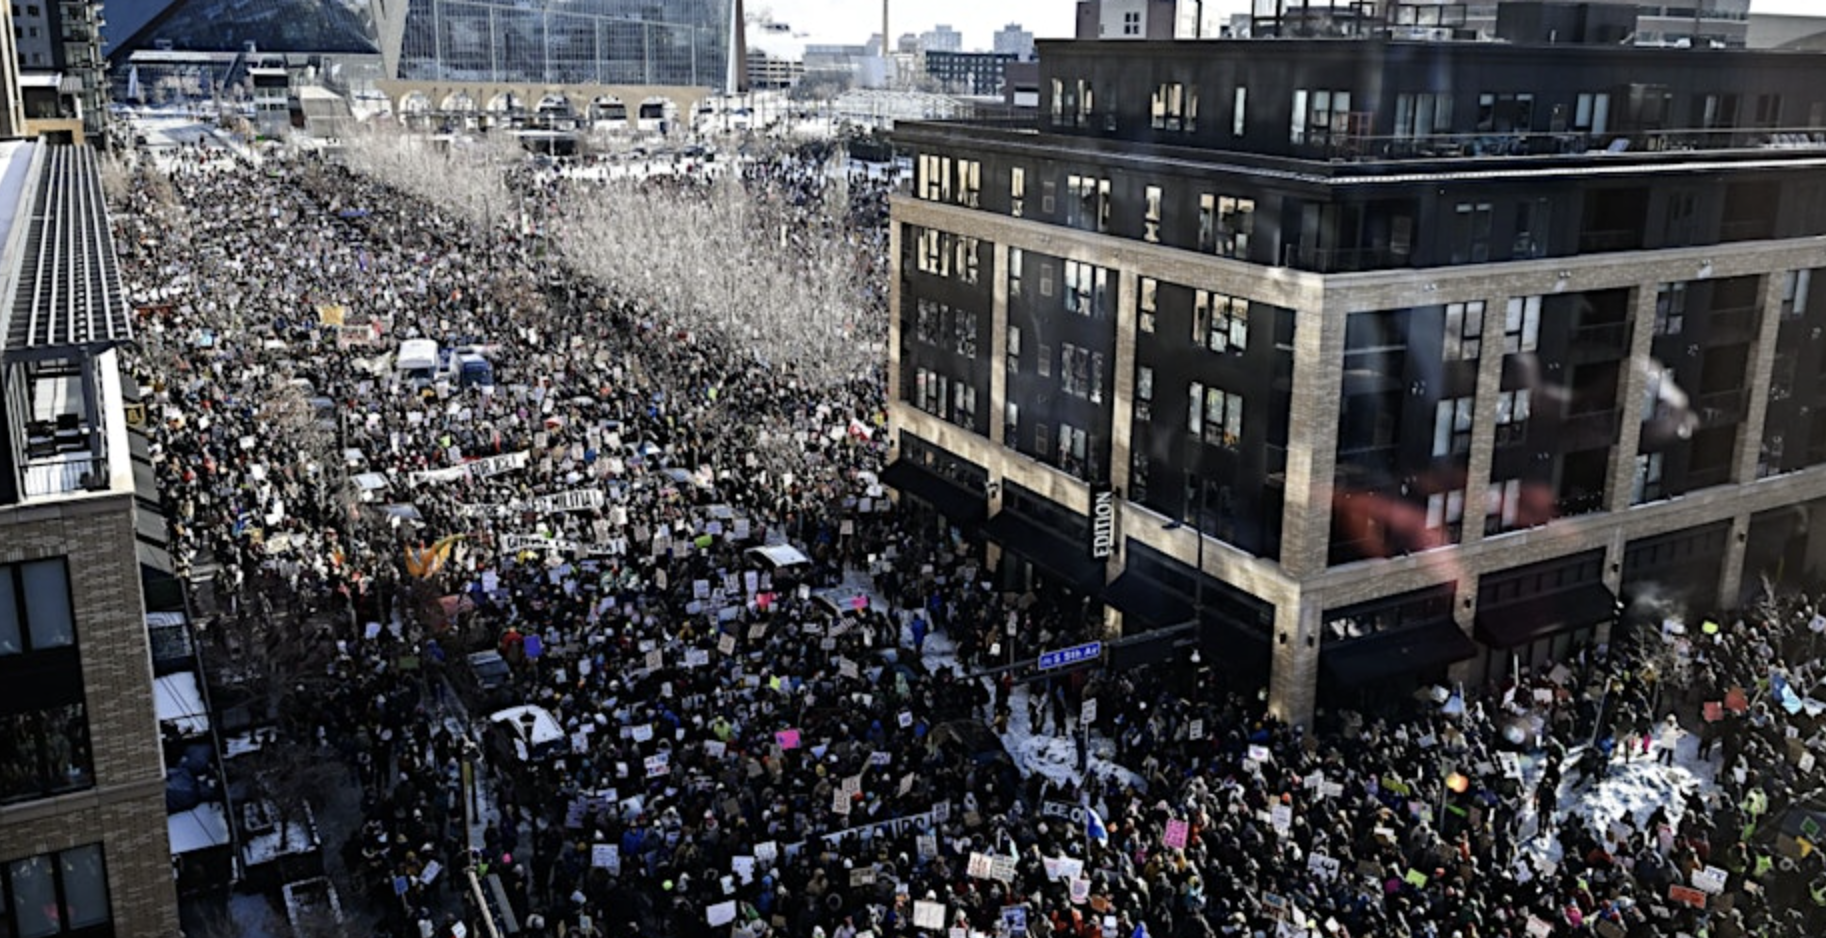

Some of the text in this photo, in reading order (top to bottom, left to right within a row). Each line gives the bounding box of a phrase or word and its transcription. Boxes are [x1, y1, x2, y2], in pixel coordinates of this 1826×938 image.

[1094, 491, 1112, 558] EDITION
[1053, 653, 1060, 663] S
[1043, 801, 1069, 819] ICE
